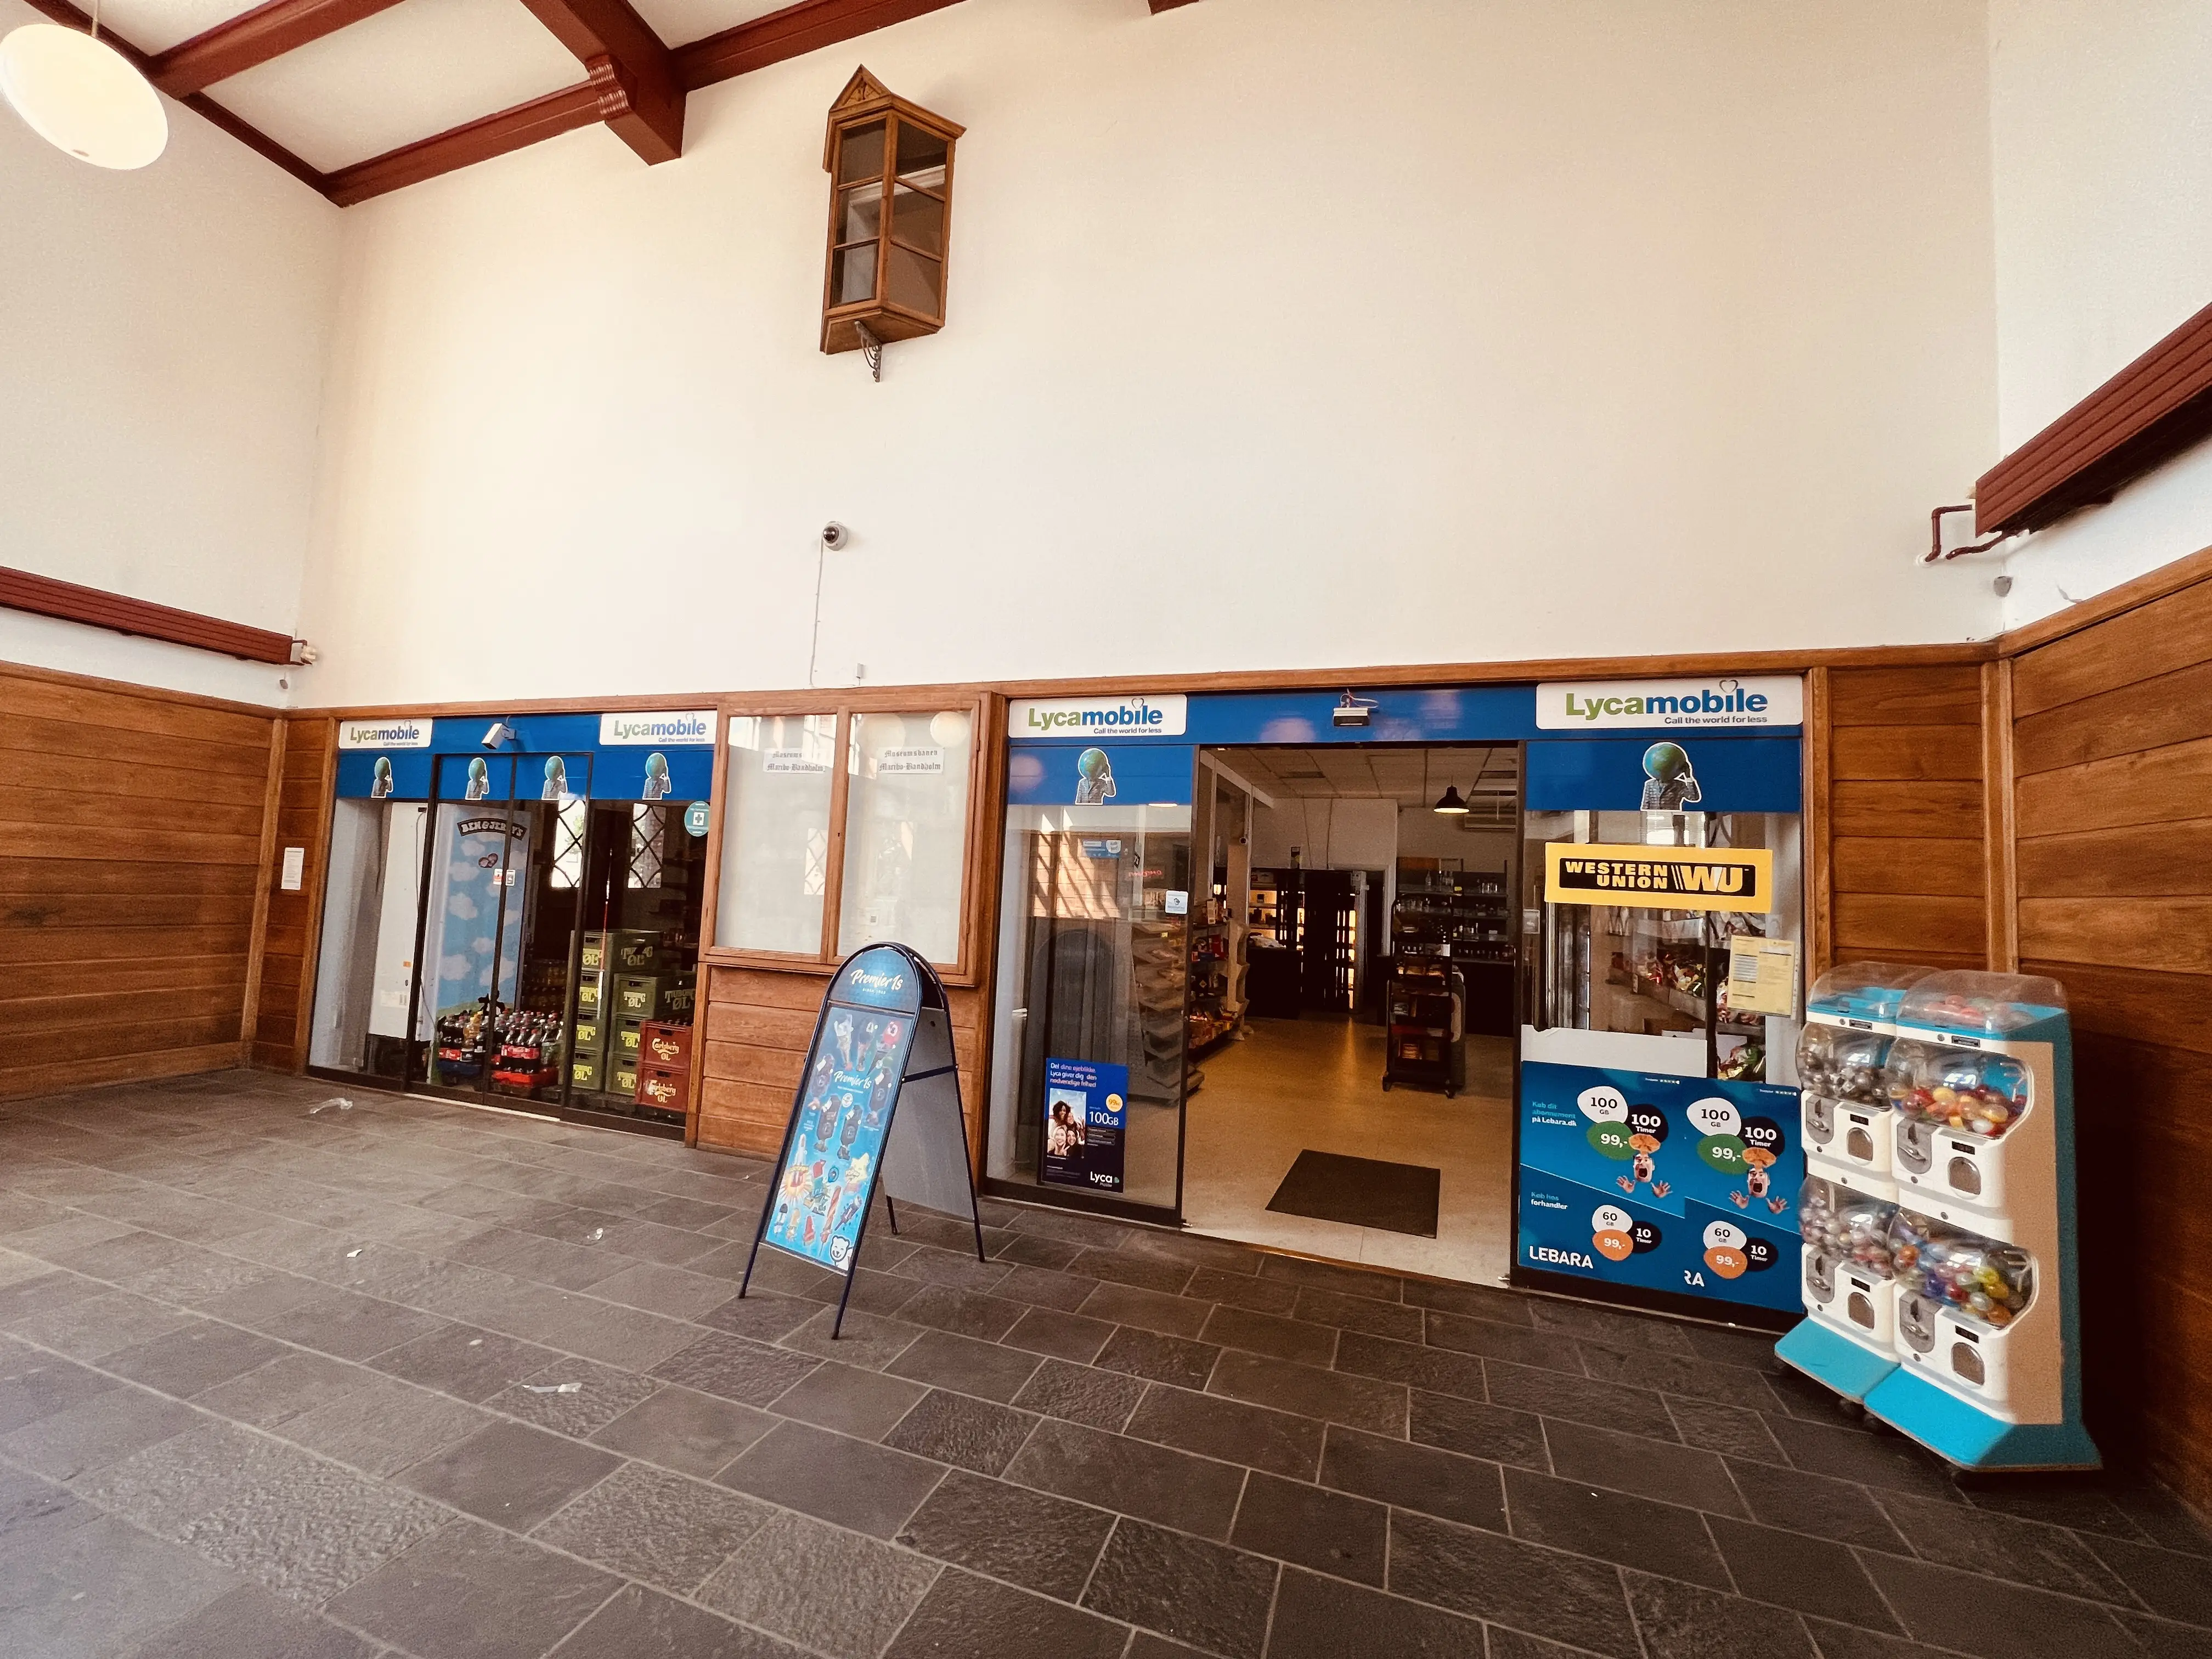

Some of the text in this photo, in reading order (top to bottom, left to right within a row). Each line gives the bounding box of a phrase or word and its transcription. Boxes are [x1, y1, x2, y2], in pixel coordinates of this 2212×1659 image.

[1566, 688, 1768, 720] Lycamobile
[1029, 705, 1163, 731] Lycamobile
[350, 726, 419, 743] Lycamobile
[614, 719, 707, 739] Lycamobile
[461, 821, 481, 833] BEN
[489, 821, 523, 837] JERY'S
[1565, 861, 1667, 877] WESTERN
[1596, 875, 1667, 889] UNION
[851, 969, 893, 988] Premier
[652, 1038, 679, 1054] Carlsberg
[834, 1071, 864, 1086] Premier
[1590, 1097, 1618, 1109] 100
[1631, 1114, 1661, 1127] 100
[1701, 1109, 1730, 1121] 100
[1600, 1133, 1628, 1148] 99,-
[1745, 1126, 1777, 1141] 100
[1750, 1139, 1771, 1147] Timer
[1712, 1147, 1741, 1162] 99,-
[1090, 1171, 1113, 1183] Lyca
[1531, 1199, 1568, 1210] forhandler
[1602, 1212, 1617, 1221] 60
[1636, 1228, 1651, 1238] 10
[1714, 1228, 1730, 1238] 60
[1604, 1238, 1625, 1250] 99,-
[1751, 1245, 1767, 1255] 10
[1530, 1245, 1593, 1269] LEBARA
[1716, 1255, 1739, 1268] 99,-
